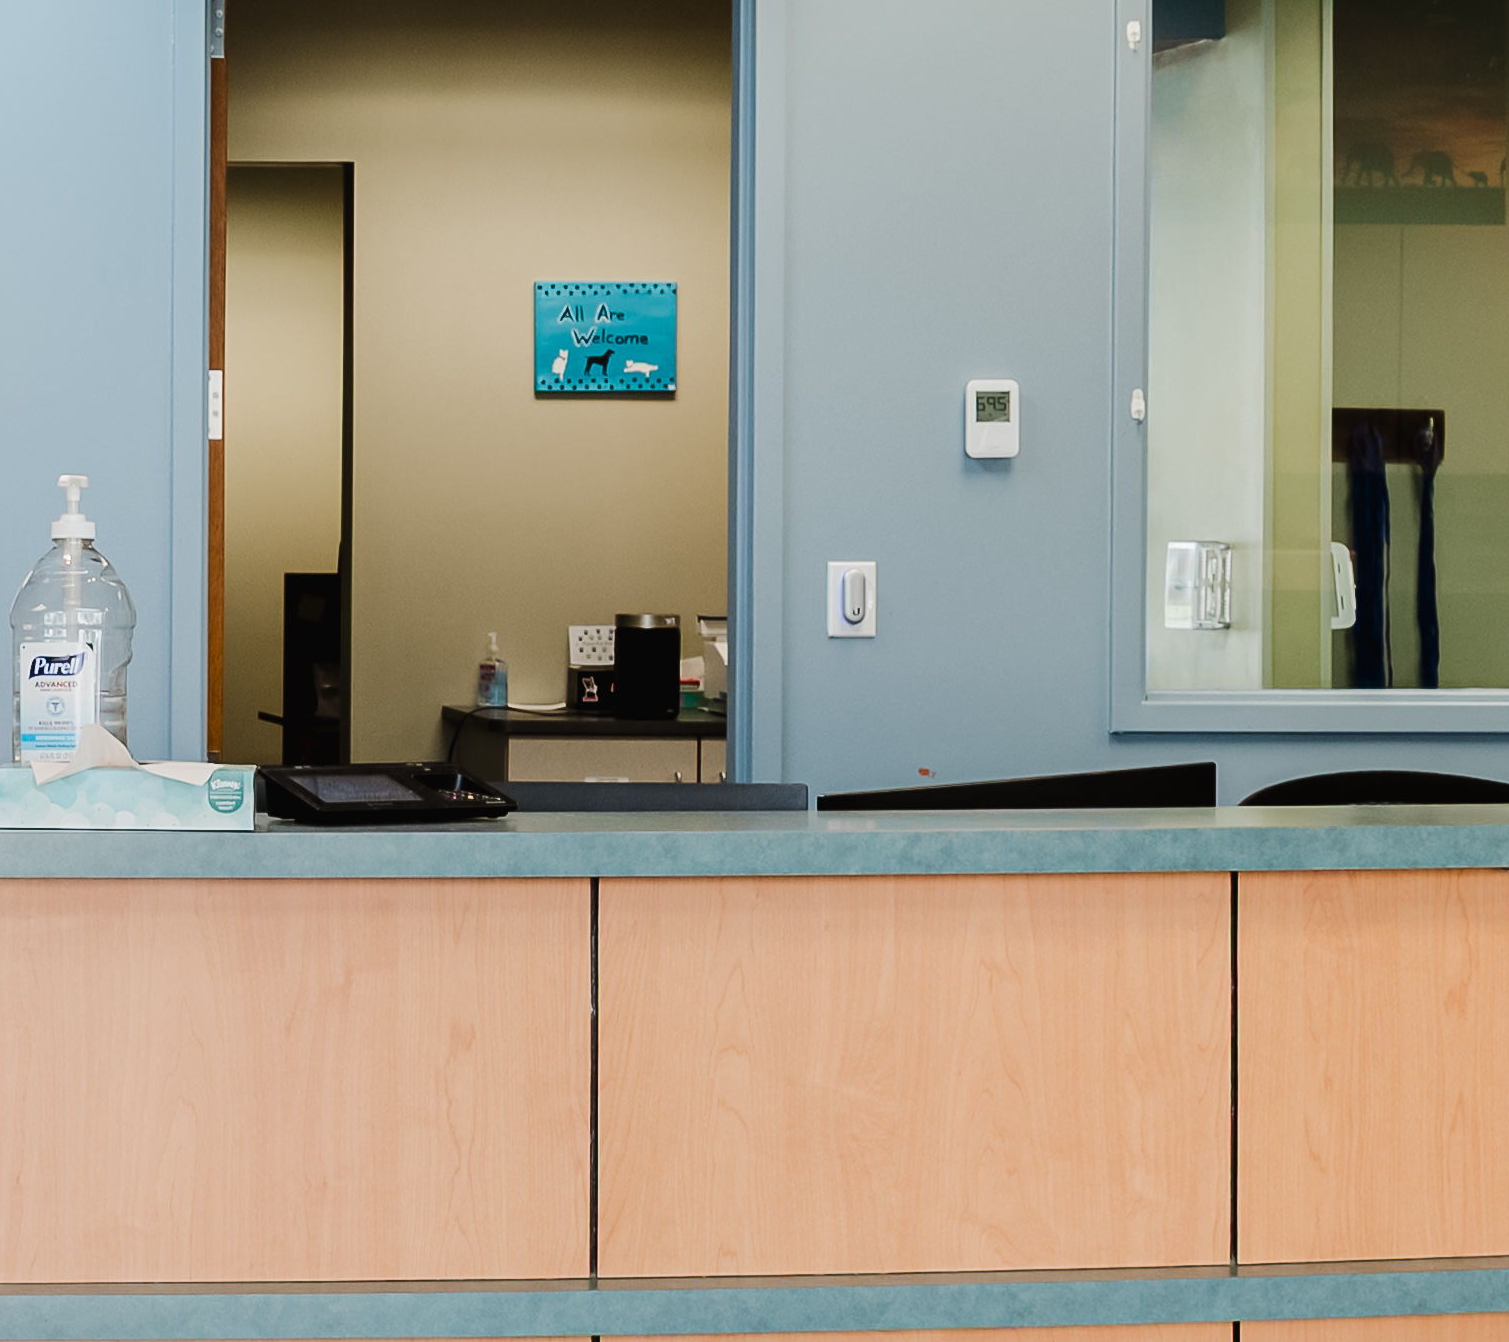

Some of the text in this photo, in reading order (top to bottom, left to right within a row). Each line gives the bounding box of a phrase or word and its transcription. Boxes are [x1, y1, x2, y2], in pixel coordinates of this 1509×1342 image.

[558, 303, 625, 323] All Are
[571, 326, 649, 347] Welcome
